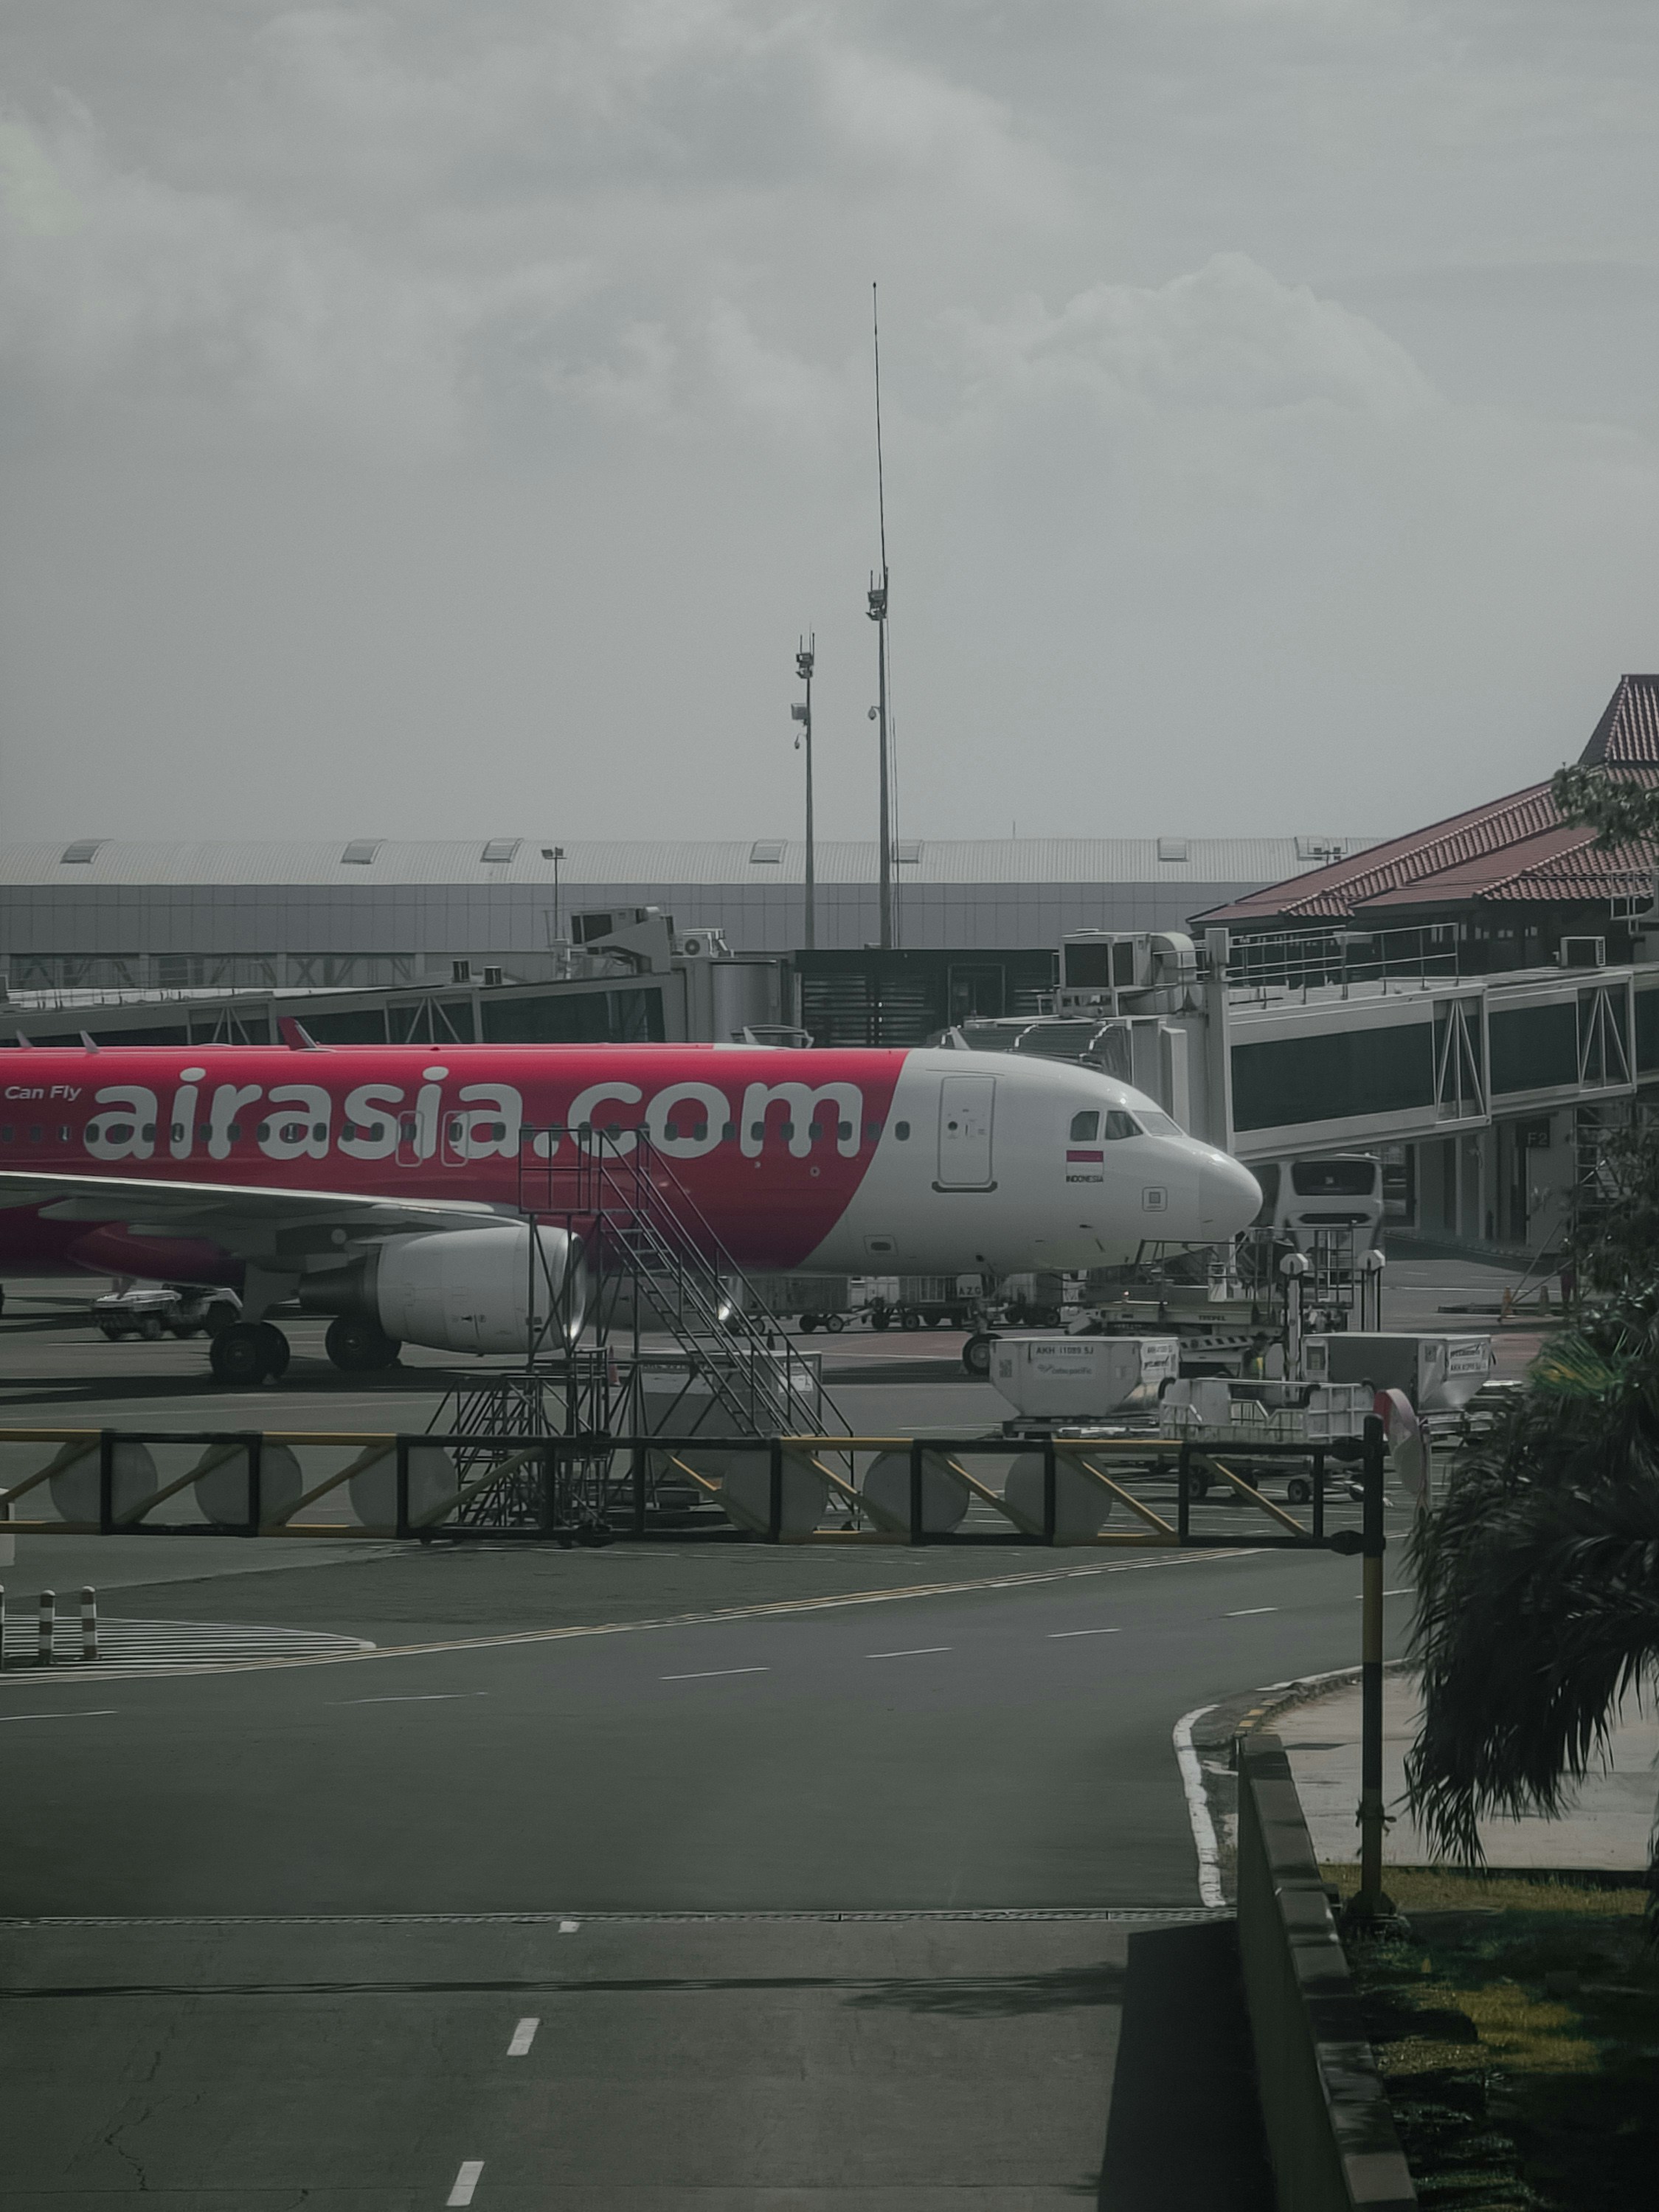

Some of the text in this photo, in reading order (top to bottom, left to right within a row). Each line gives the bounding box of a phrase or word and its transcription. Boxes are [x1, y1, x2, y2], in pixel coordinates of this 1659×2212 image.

[4, 1085, 83, 1102] Can Fly
[83, 1066, 864, 1161] airasia.com
[1528, 1133, 1548, 1145] F2
[1036, 1347, 1055, 1355] AKH
